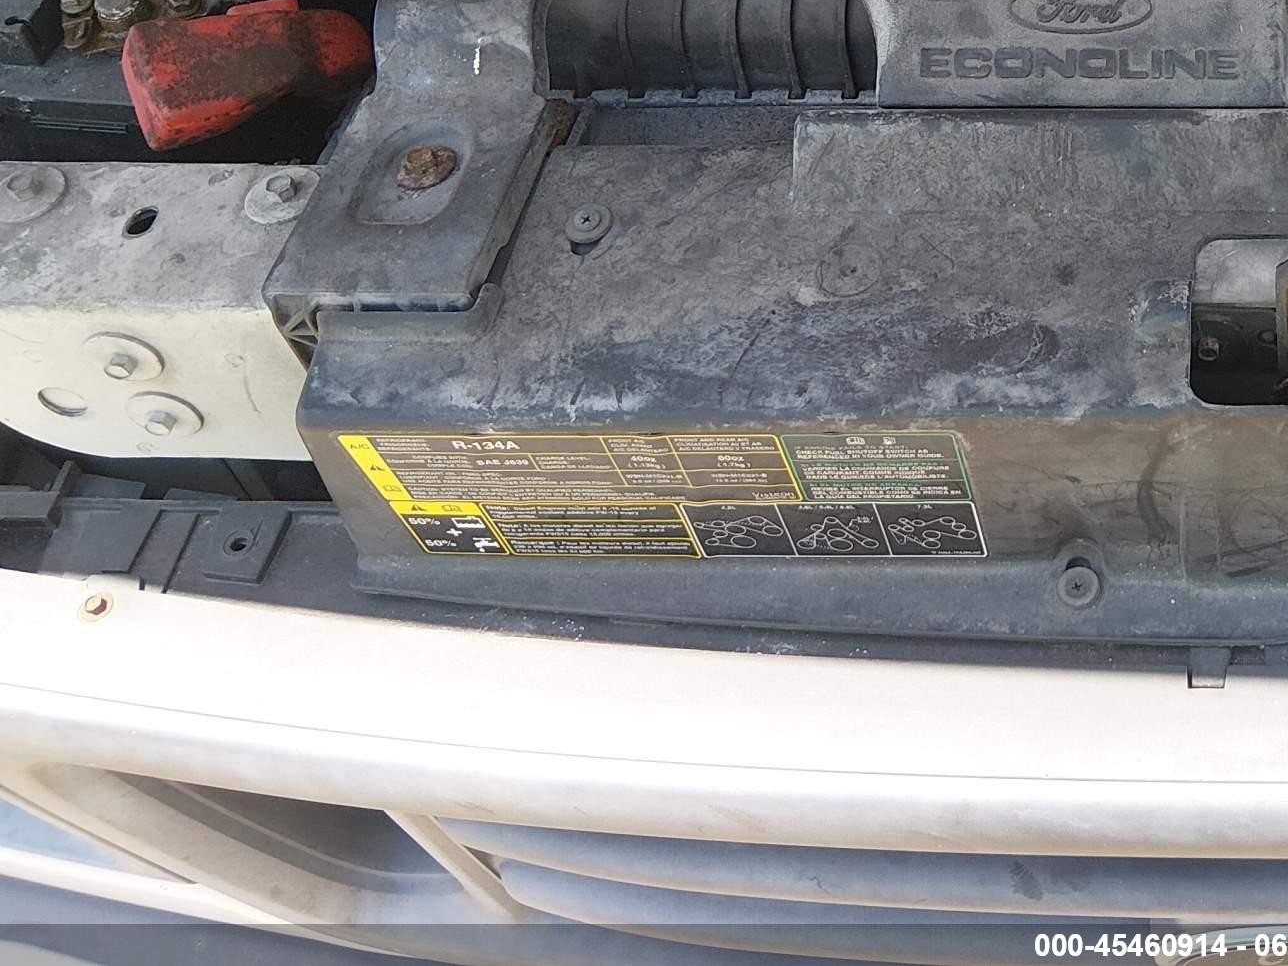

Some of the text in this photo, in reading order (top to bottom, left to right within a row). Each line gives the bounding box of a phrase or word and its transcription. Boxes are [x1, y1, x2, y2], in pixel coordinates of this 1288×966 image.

[919, 47, 1242, 81] ECONOLINE
[451, 439, 521, 450] R-134A
[752, 492, 796, 500] Visteon
[408, 517, 441, 525] 50%
[425, 539, 457, 547] 50%
